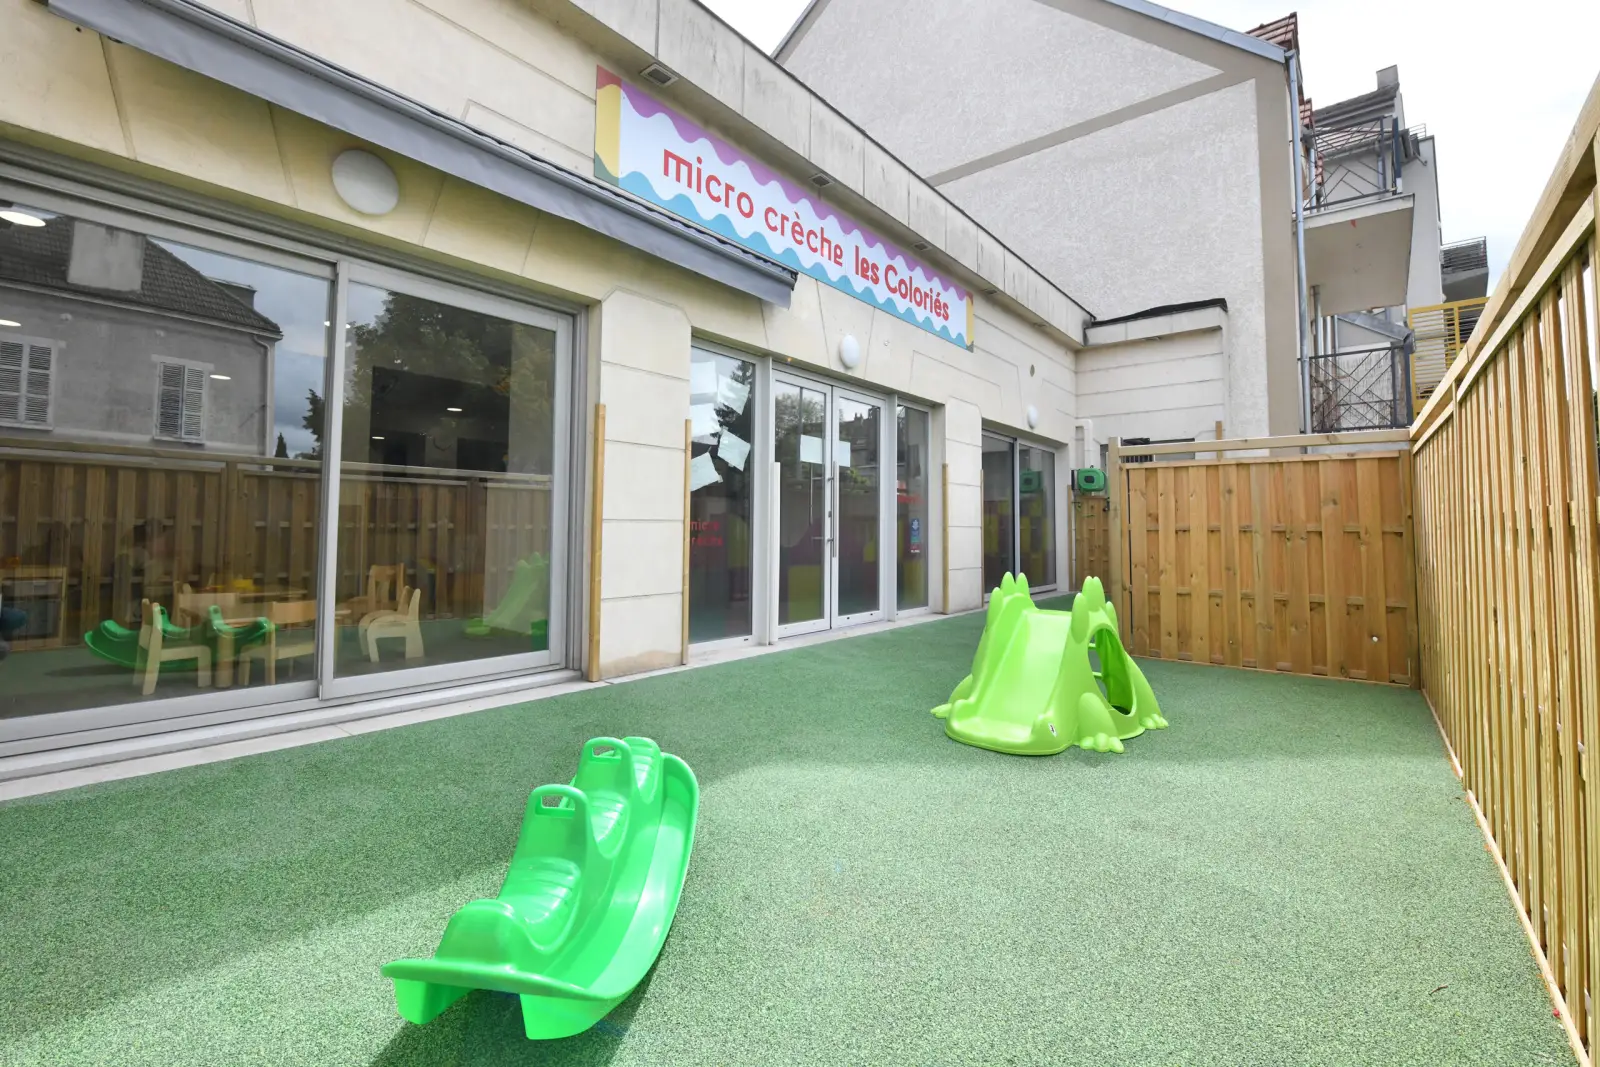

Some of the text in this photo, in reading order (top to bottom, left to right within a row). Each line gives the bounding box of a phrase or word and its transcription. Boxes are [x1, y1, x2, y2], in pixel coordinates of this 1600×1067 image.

[663, 148, 950, 322] micro crèche les Coloriés
